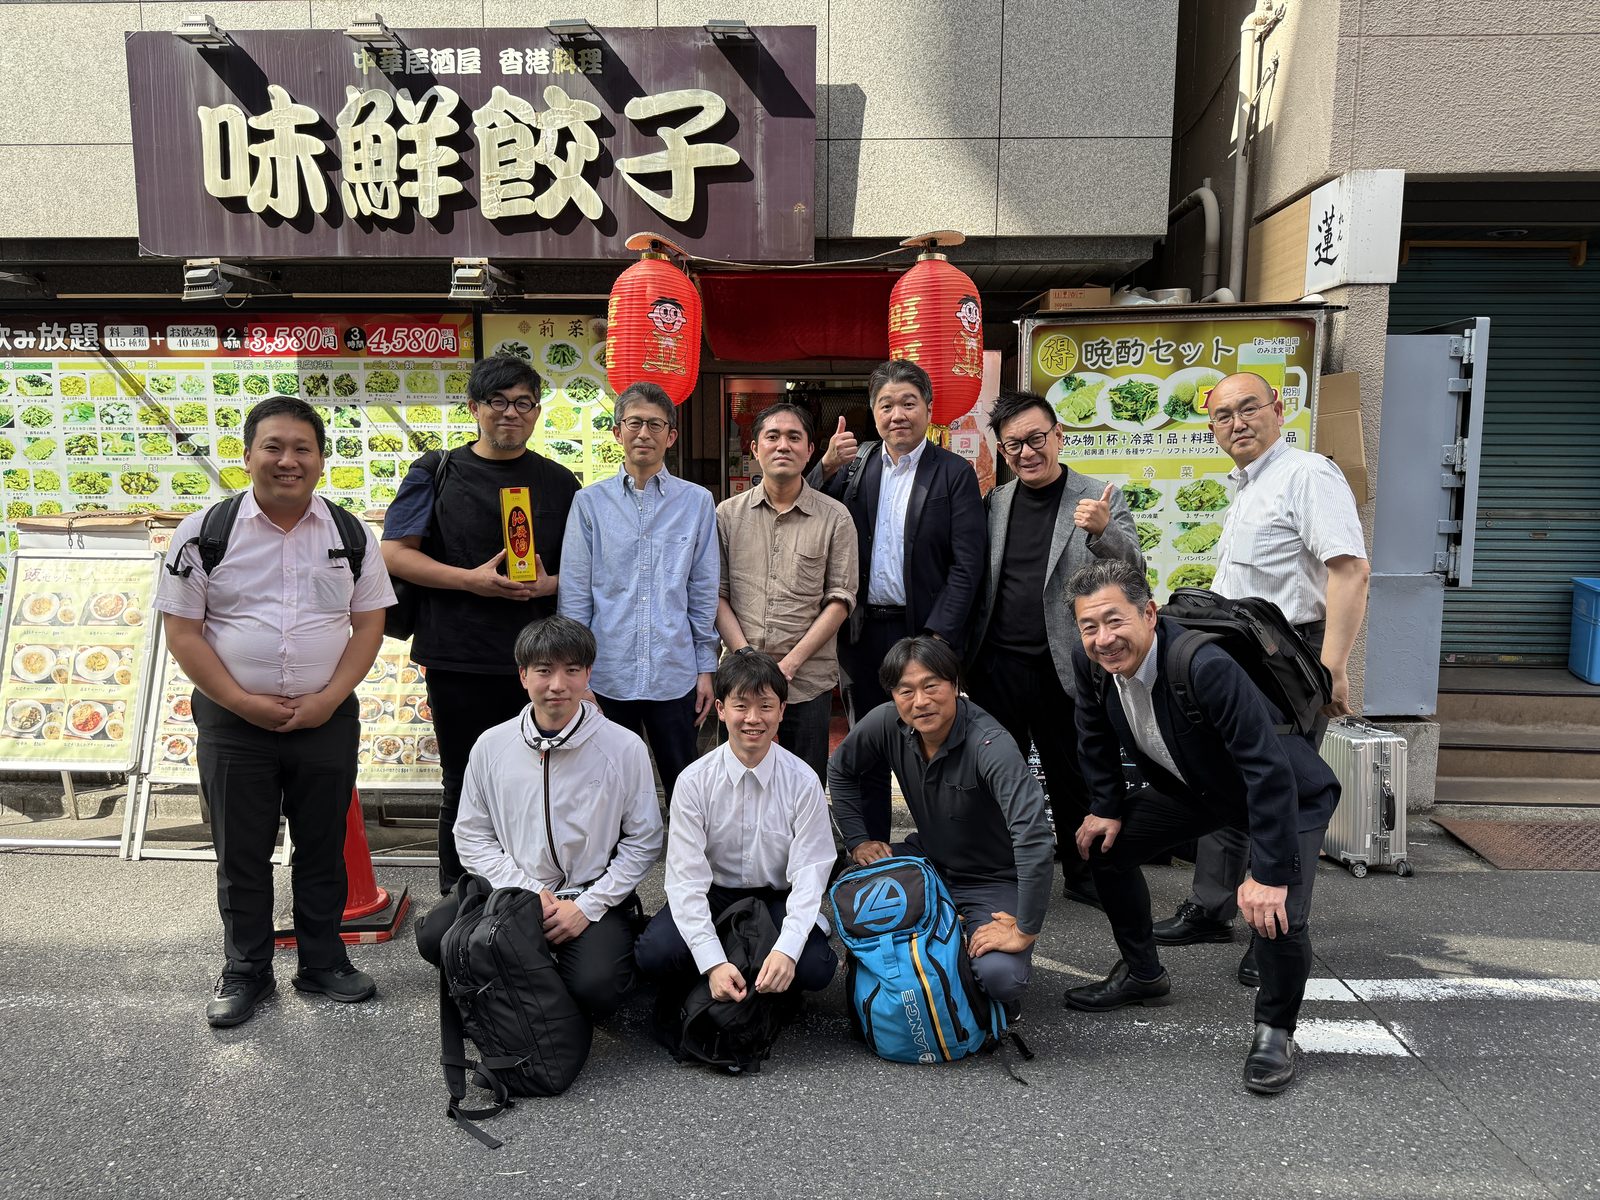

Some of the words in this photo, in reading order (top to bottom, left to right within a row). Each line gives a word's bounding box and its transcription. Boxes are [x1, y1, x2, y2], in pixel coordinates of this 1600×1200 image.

[353, 47, 482, 75] 中華居酒屋
[499, 47, 602, 75] 香港料理
[197, 84, 741, 222] 味鮮餃子
[109, 326, 145, 337] 料理
[169, 326, 216, 337] お飲み物
[538, 318, 584, 338] 前菜
[1040, 338, 1074, 370] 得
[1083, 337, 1234, 367] 晩酌セット
